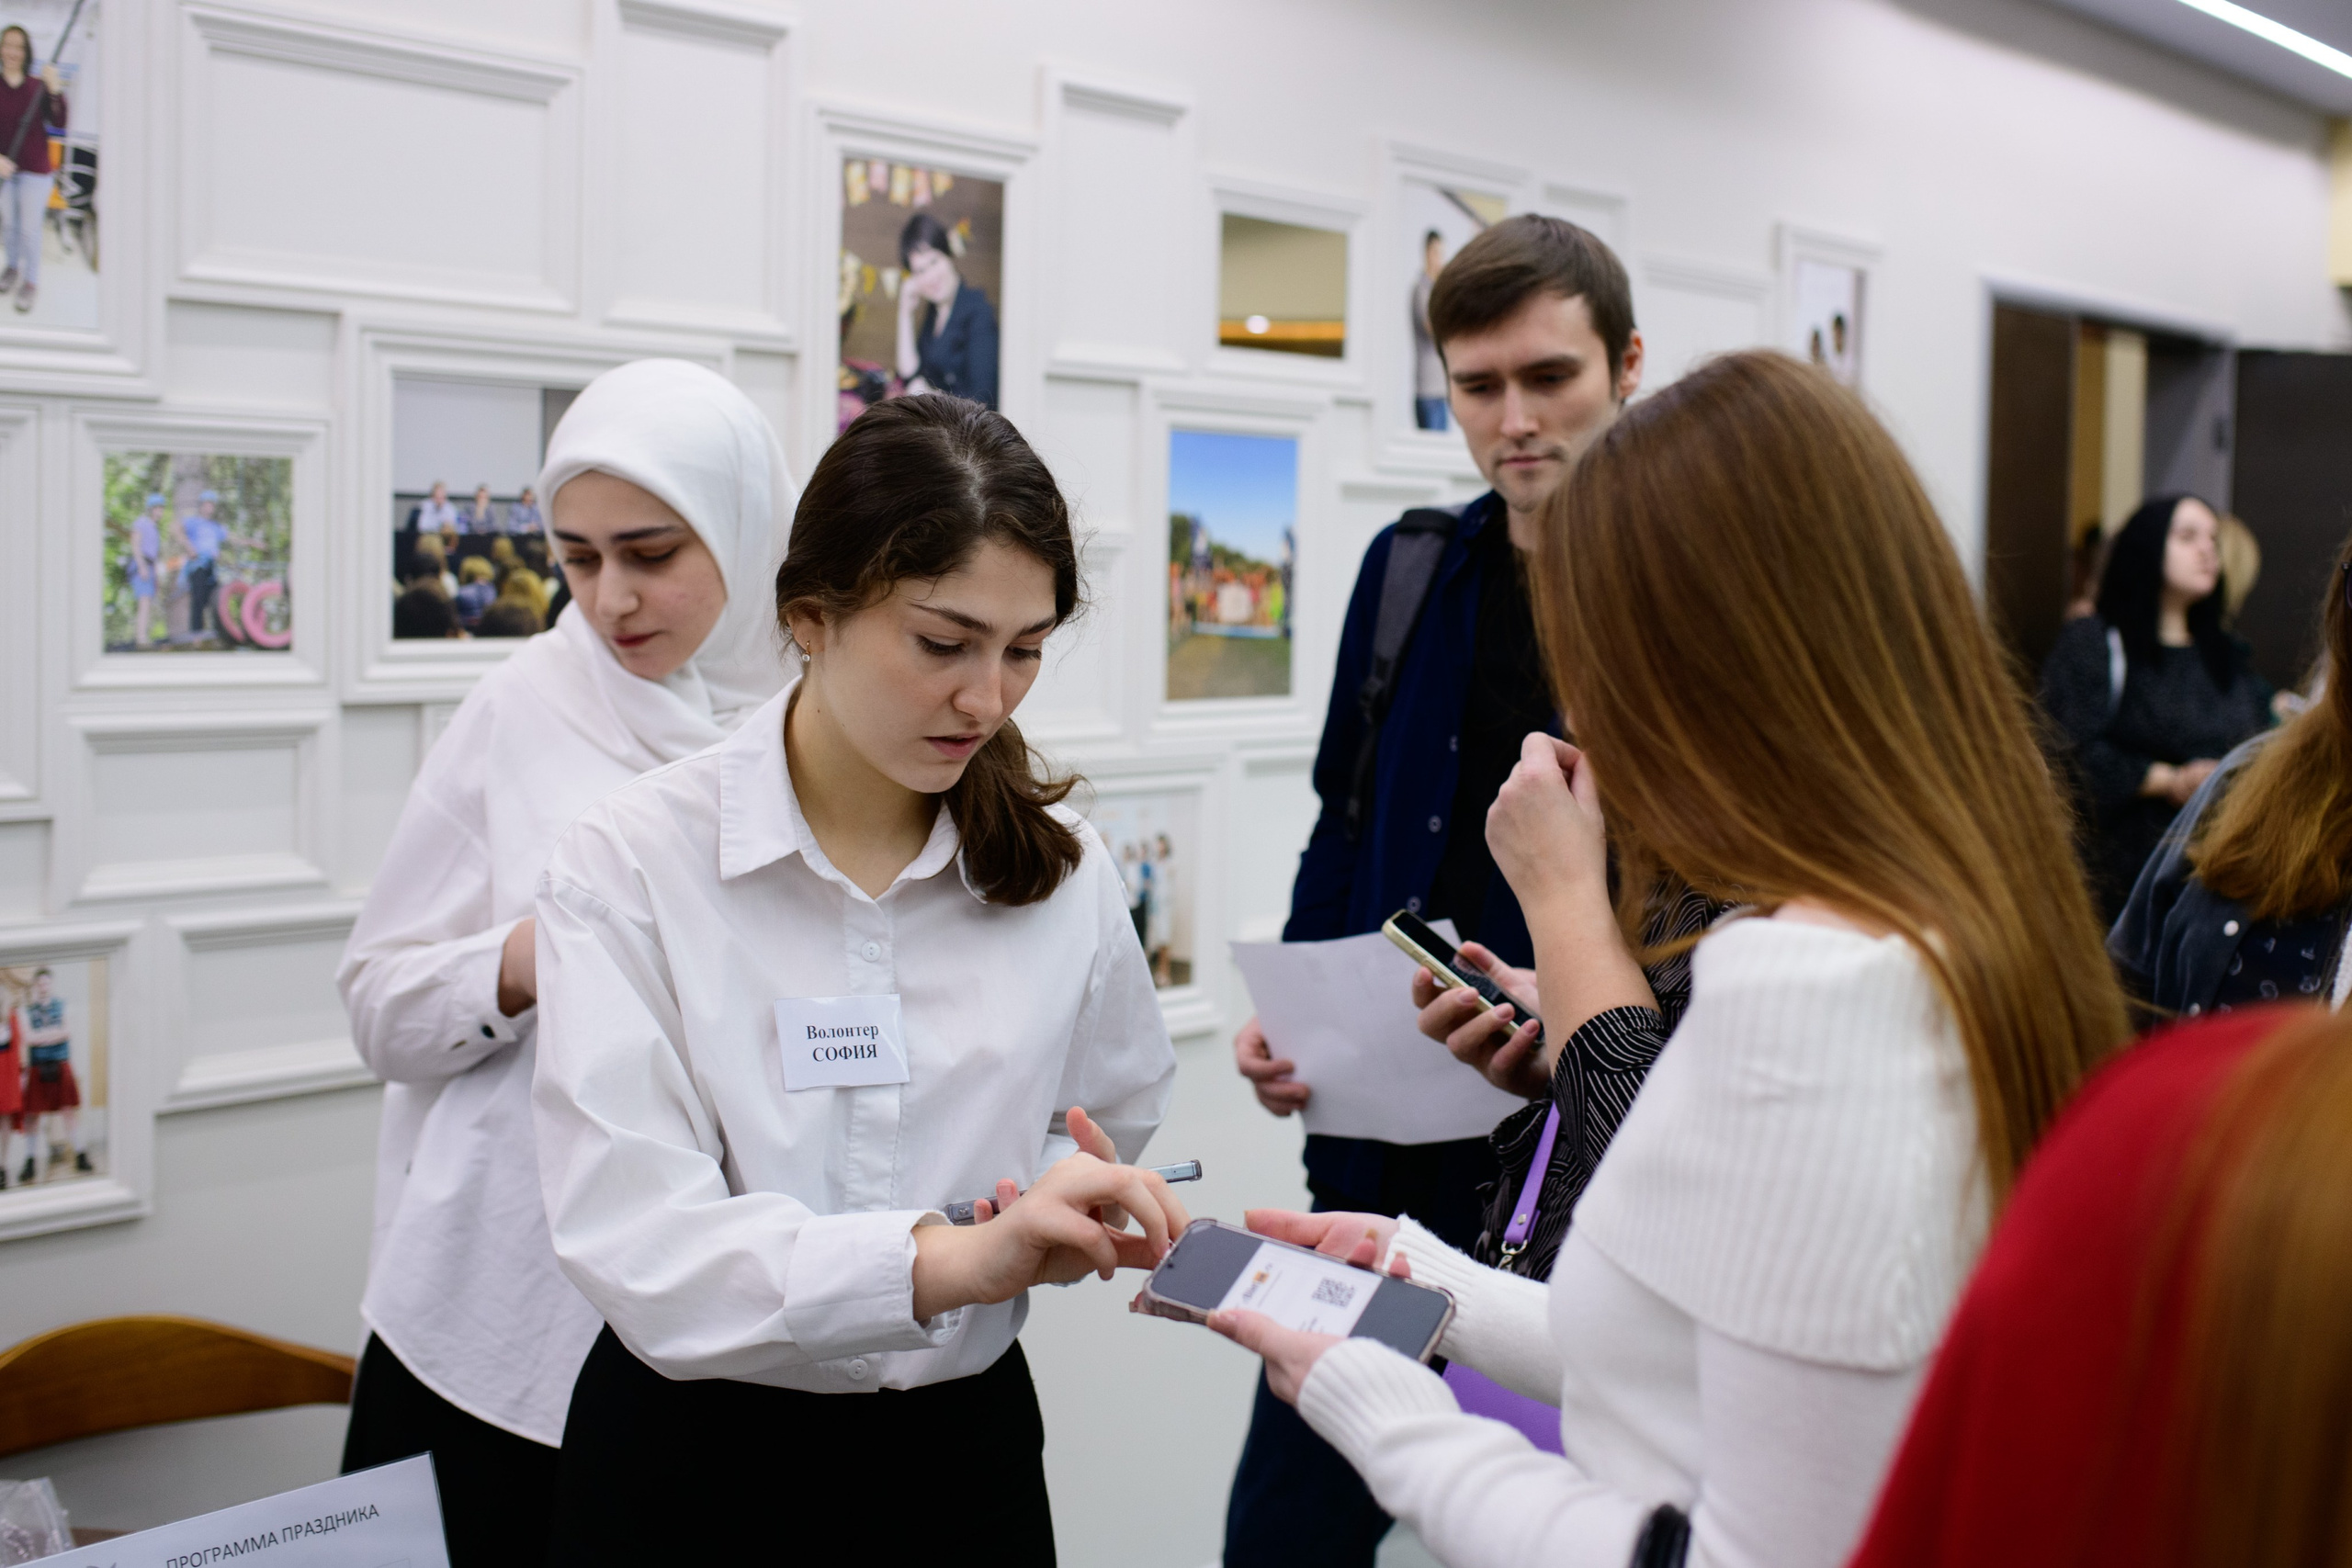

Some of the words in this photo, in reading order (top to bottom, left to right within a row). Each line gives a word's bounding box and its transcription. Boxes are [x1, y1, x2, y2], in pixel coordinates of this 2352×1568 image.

[806, 1024, 879, 1040] Волонтер
[812, 1043, 878, 1062] СОФИЯ
[166, 1531, 278, 1568] ПРОГРАММА
[282, 1504, 379, 1543] ПРАЗДНИКА
